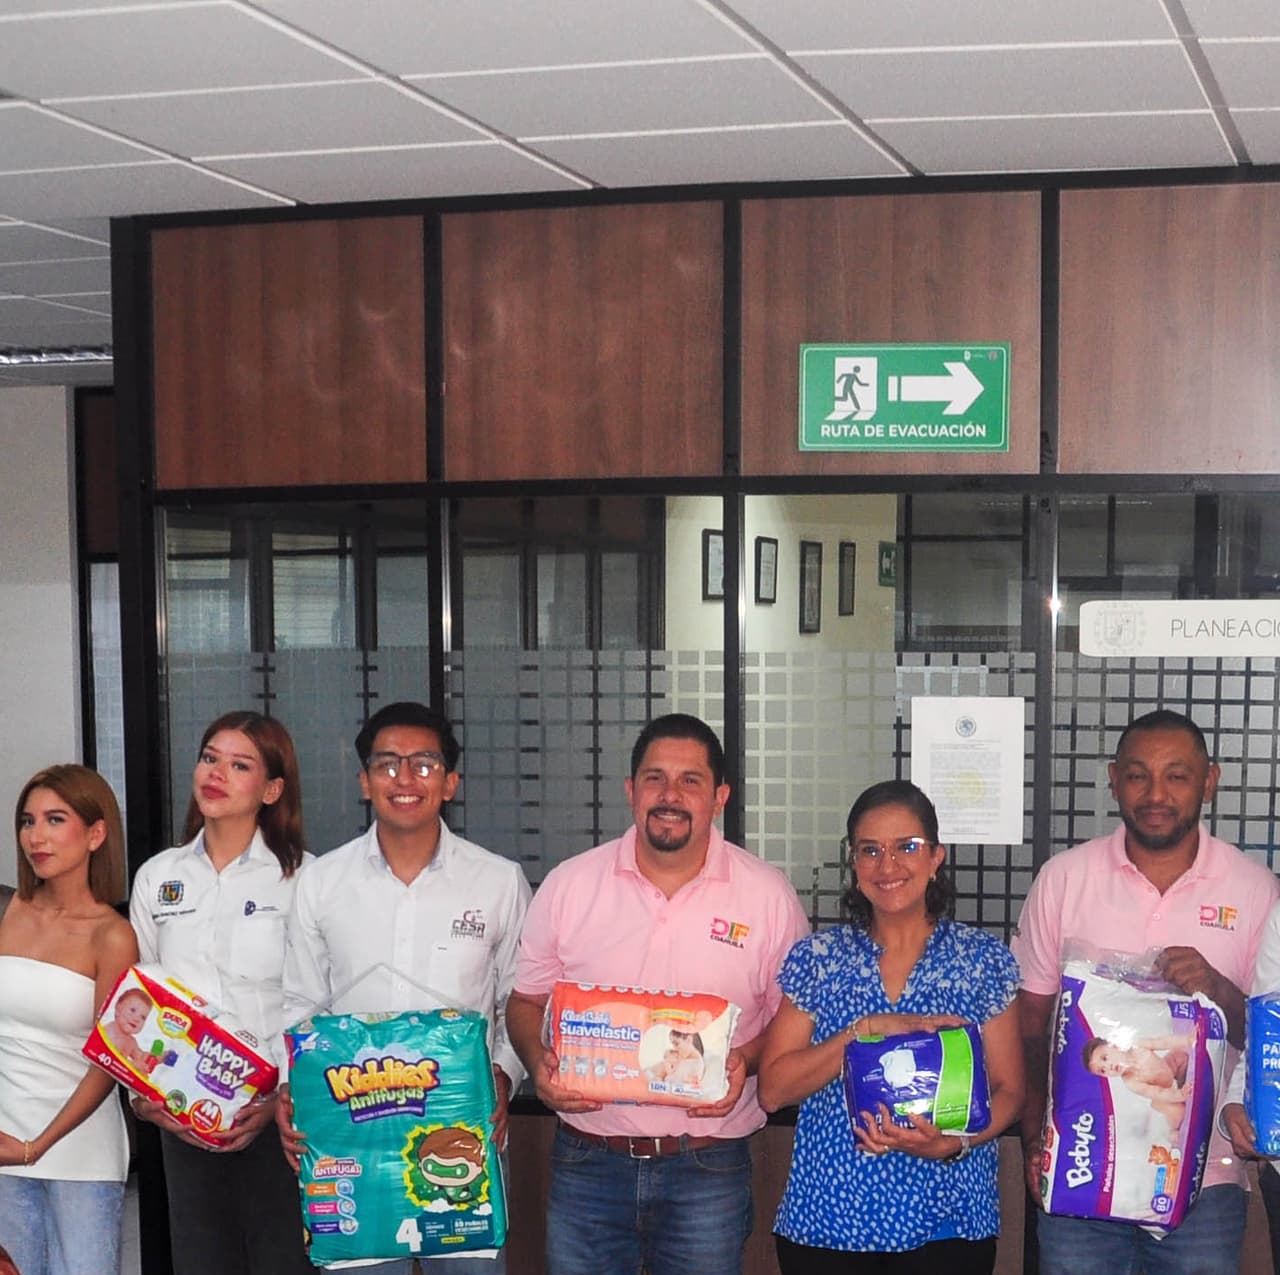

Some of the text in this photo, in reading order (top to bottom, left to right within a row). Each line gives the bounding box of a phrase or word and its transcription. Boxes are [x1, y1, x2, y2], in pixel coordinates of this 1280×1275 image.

[821, 421, 986, 438] RUTA DE EVACUACIÓN
[1200, 905, 1238, 923] DIF
[711, 918, 751, 942] DIF
[559, 1022, 640, 1041] Suavelastic
[97, 1052, 112, 1067] 40
[197, 1034, 257, 1078] HAPPY
[197, 1057, 245, 1091] BABY
[326, 1057, 438, 1101] Kiddies
[201, 1100, 219, 1120] M
[349, 1086, 425, 1111] Antifugas
[1065, 1111, 1095, 1190] Bebyto
[396, 1218, 423, 1253] 4
